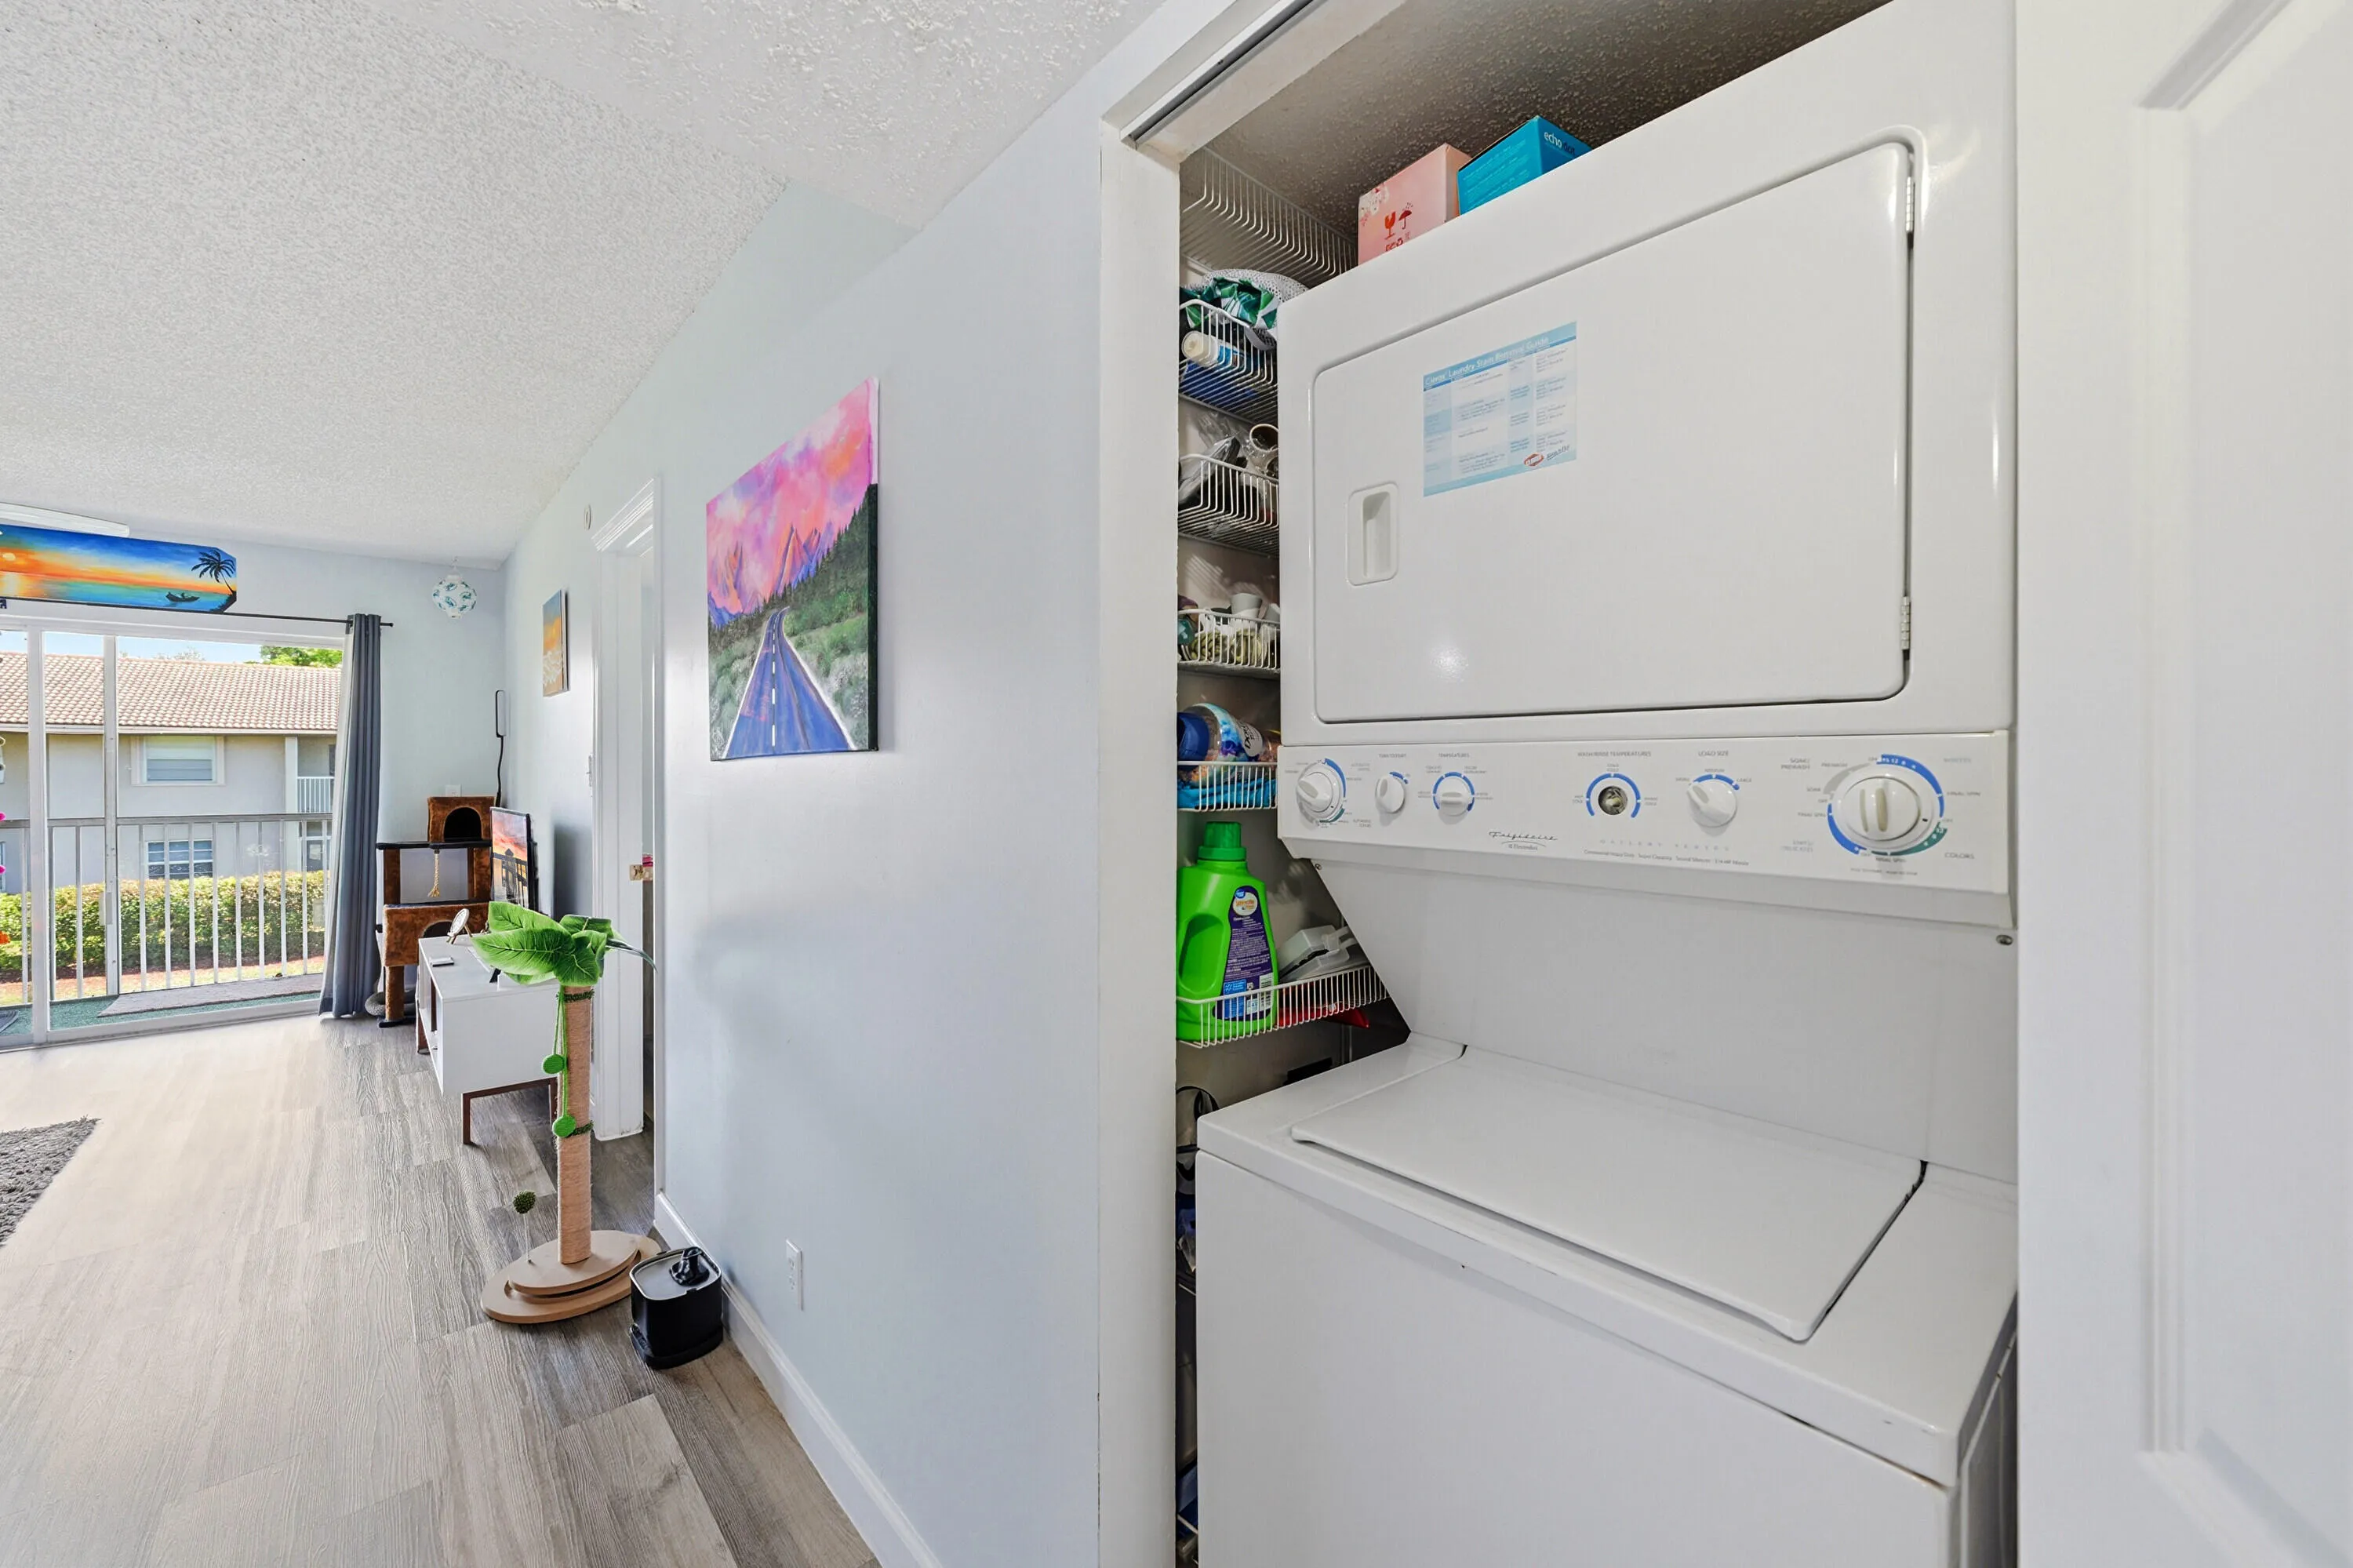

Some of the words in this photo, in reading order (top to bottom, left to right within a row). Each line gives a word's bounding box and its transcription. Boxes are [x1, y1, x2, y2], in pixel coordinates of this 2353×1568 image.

[1544, 132, 1562, 148] echo
[1449, 360, 1475, 377] Laundry
[1476, 357, 1494, 369] Stain
